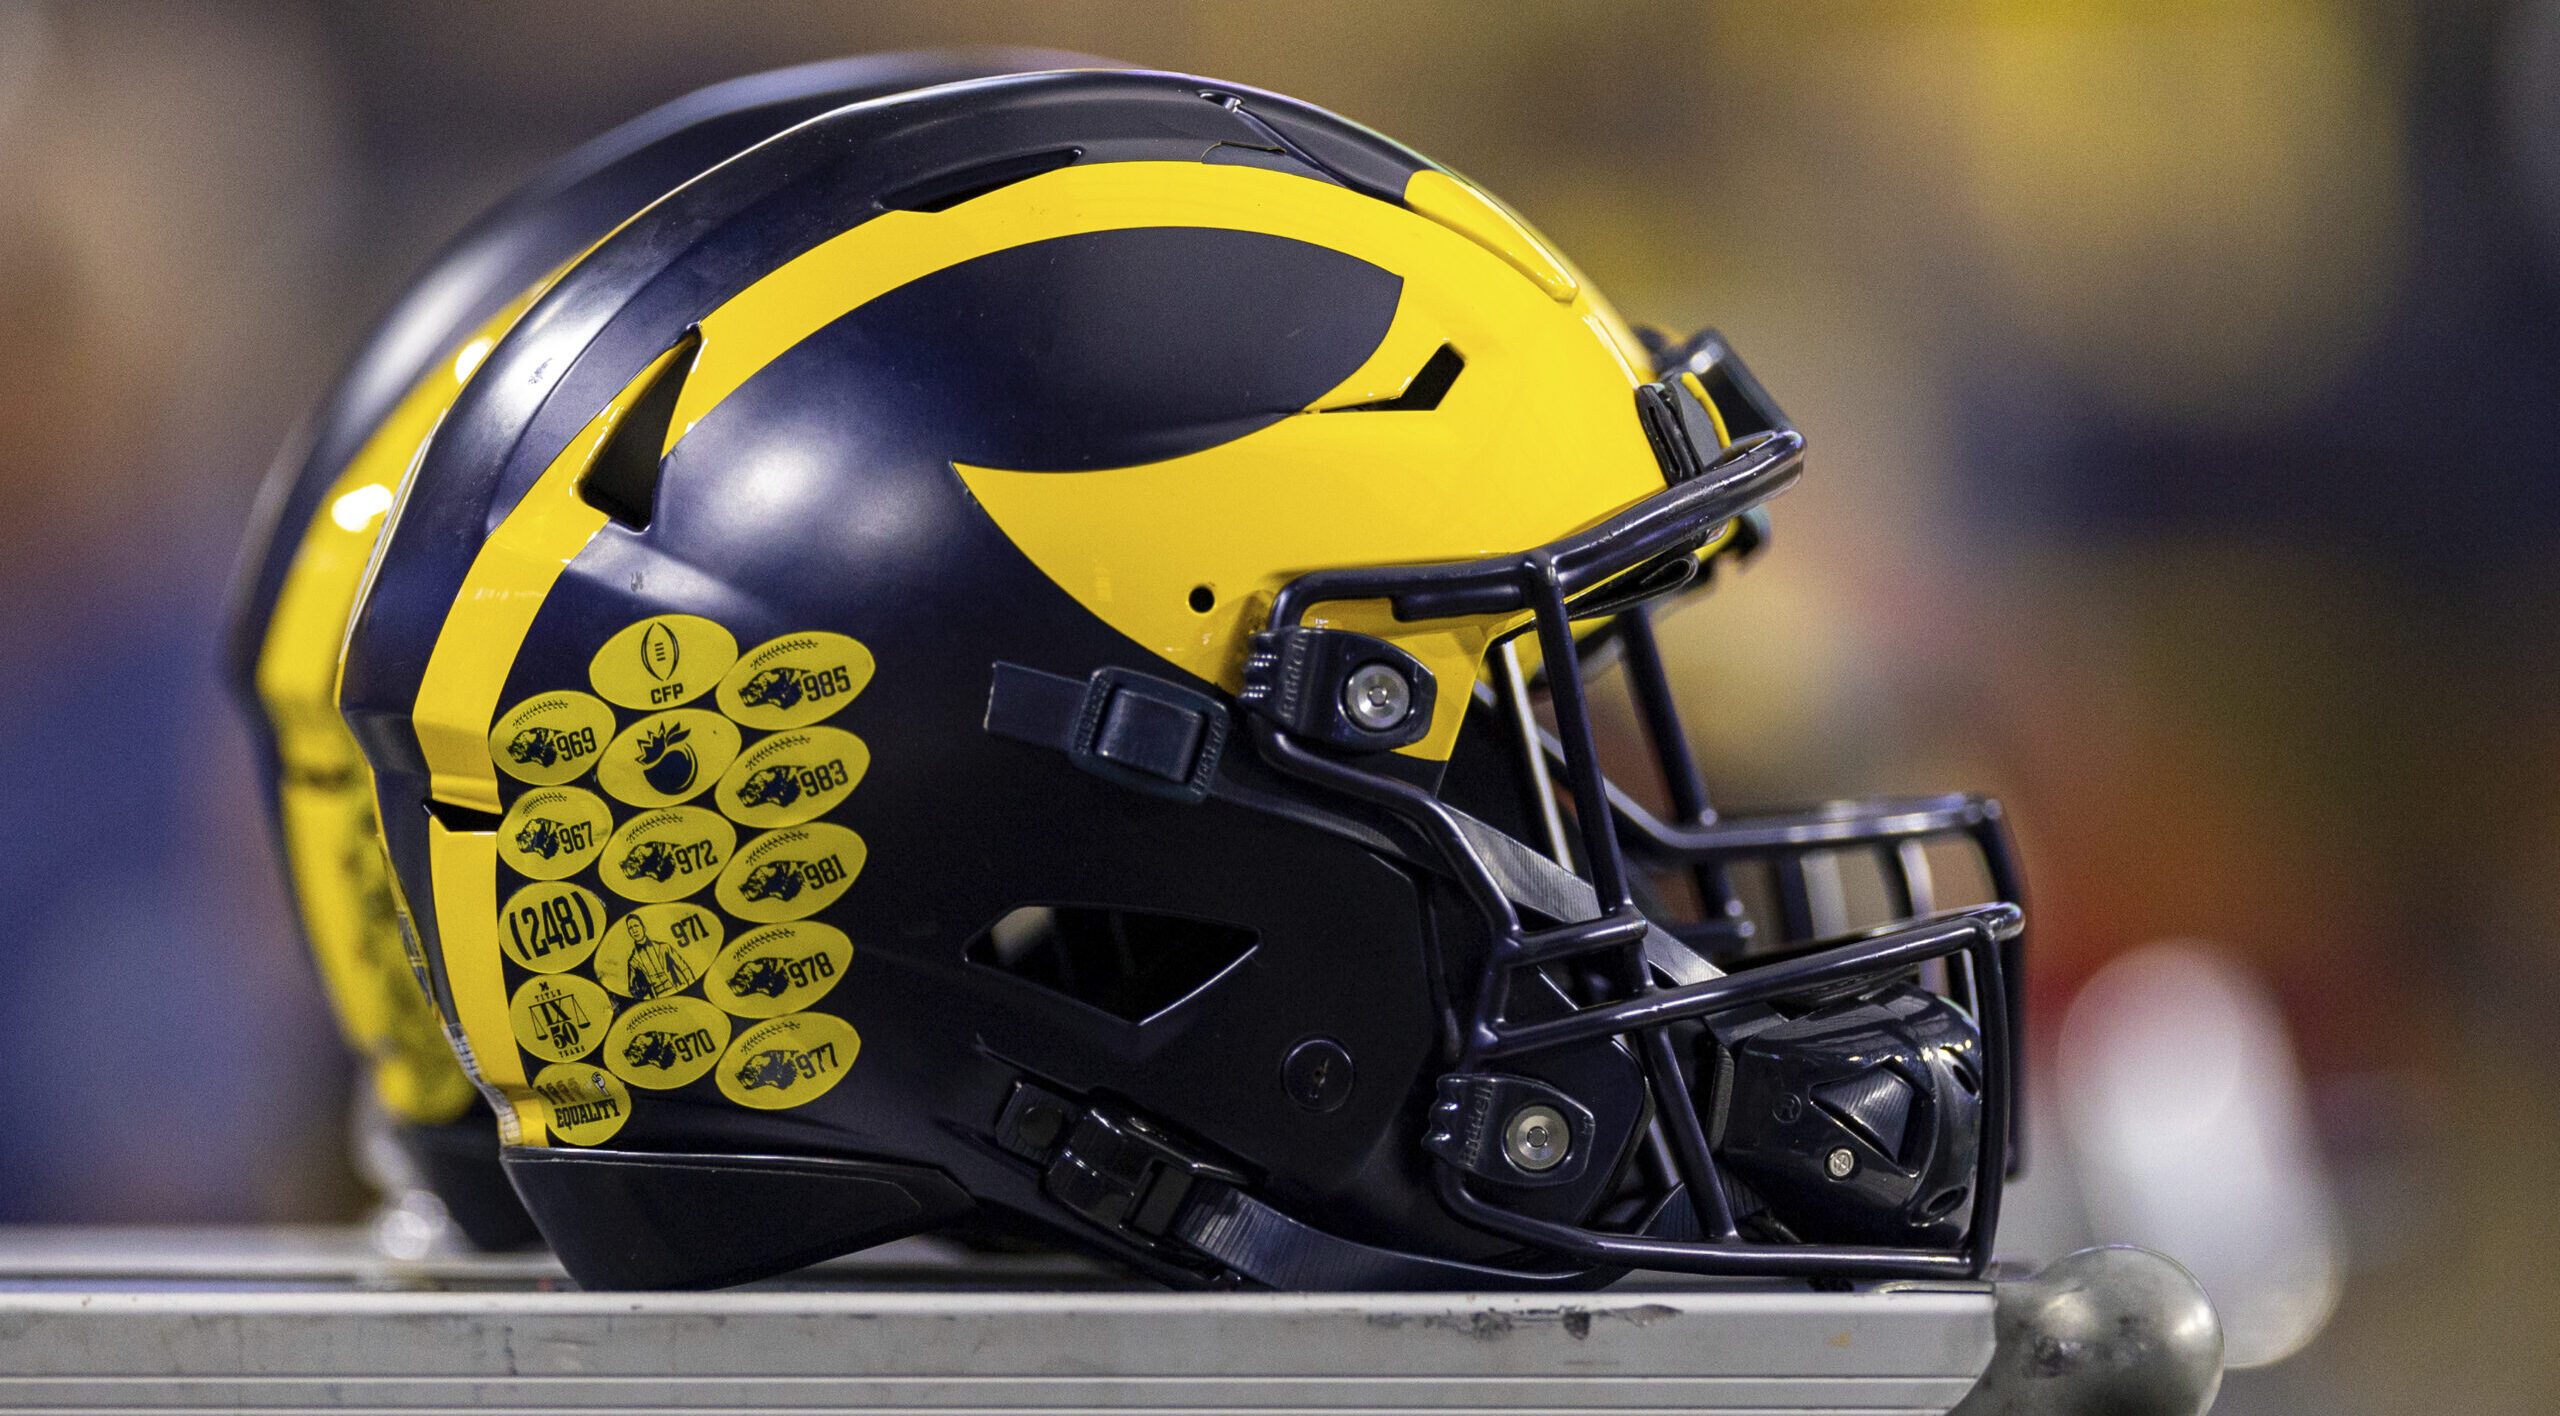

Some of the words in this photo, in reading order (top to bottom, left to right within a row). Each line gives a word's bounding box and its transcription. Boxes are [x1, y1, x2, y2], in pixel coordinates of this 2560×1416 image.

[649, 682, 684, 705] CFP
[802, 665, 852, 702] 985
[556, 726, 597, 762] 969
[801, 758, 849, 797] 983
[558, 820, 593, 854] 967
[674, 839, 718, 875] 972
[802, 854, 847, 891] 981
[509, 890, 596, 961] (248)
[670, 912, 710, 949] 971
[788, 951, 836, 989] 978
[535, 989, 562, 1002] TITLE
[540, 999, 572, 1027] IX
[549, 1021, 580, 1050] 50
[674, 1029, 716, 1063] 970
[796, 1042, 839, 1079] 977
[554, 1098, 620, 1130] EQUALITY
